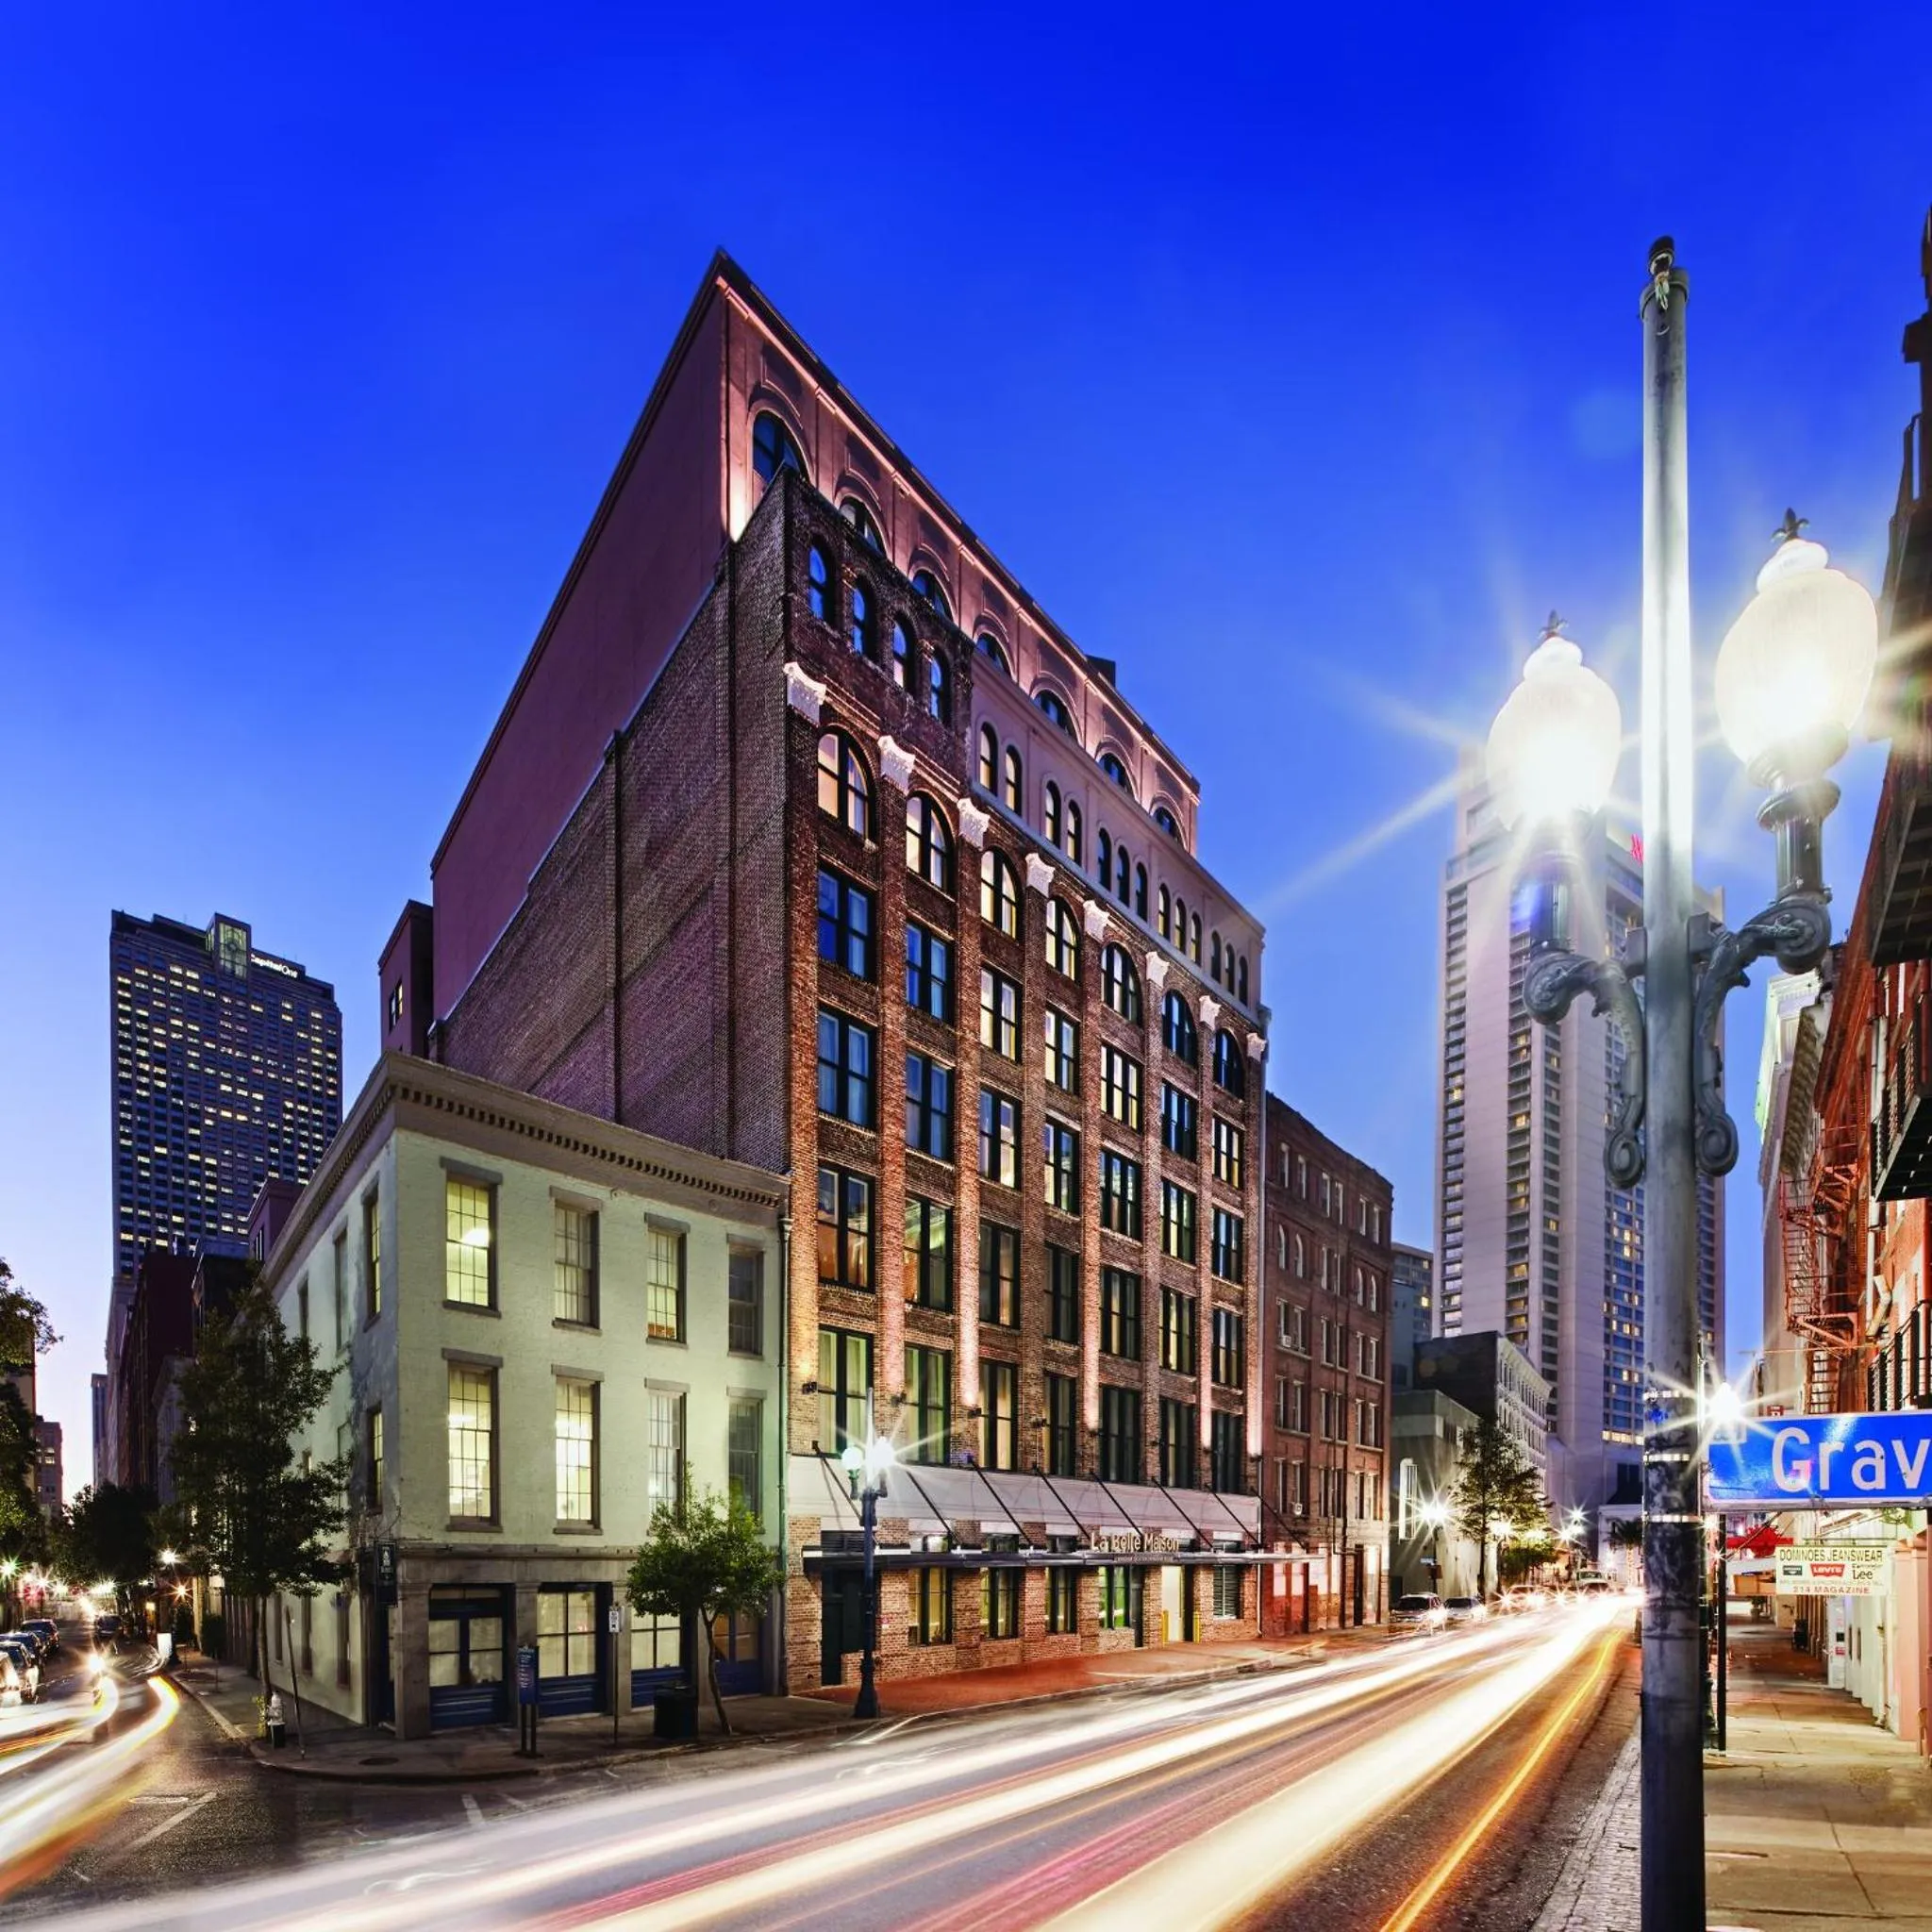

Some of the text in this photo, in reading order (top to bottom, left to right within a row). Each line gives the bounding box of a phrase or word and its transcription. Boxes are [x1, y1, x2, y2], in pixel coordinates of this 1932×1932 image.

[1772, 1426, 1932, 1492] Grav
[1091, 1532, 1109, 1552] La
[1112, 1532, 1141, 1552] Belle
[1779, 1549, 1883, 1562] DOMINOES JEANSWEAR
[1853, 1569, 1874, 1580] Lee
[1814, 1586, 1871, 1594] MAGAZINE
